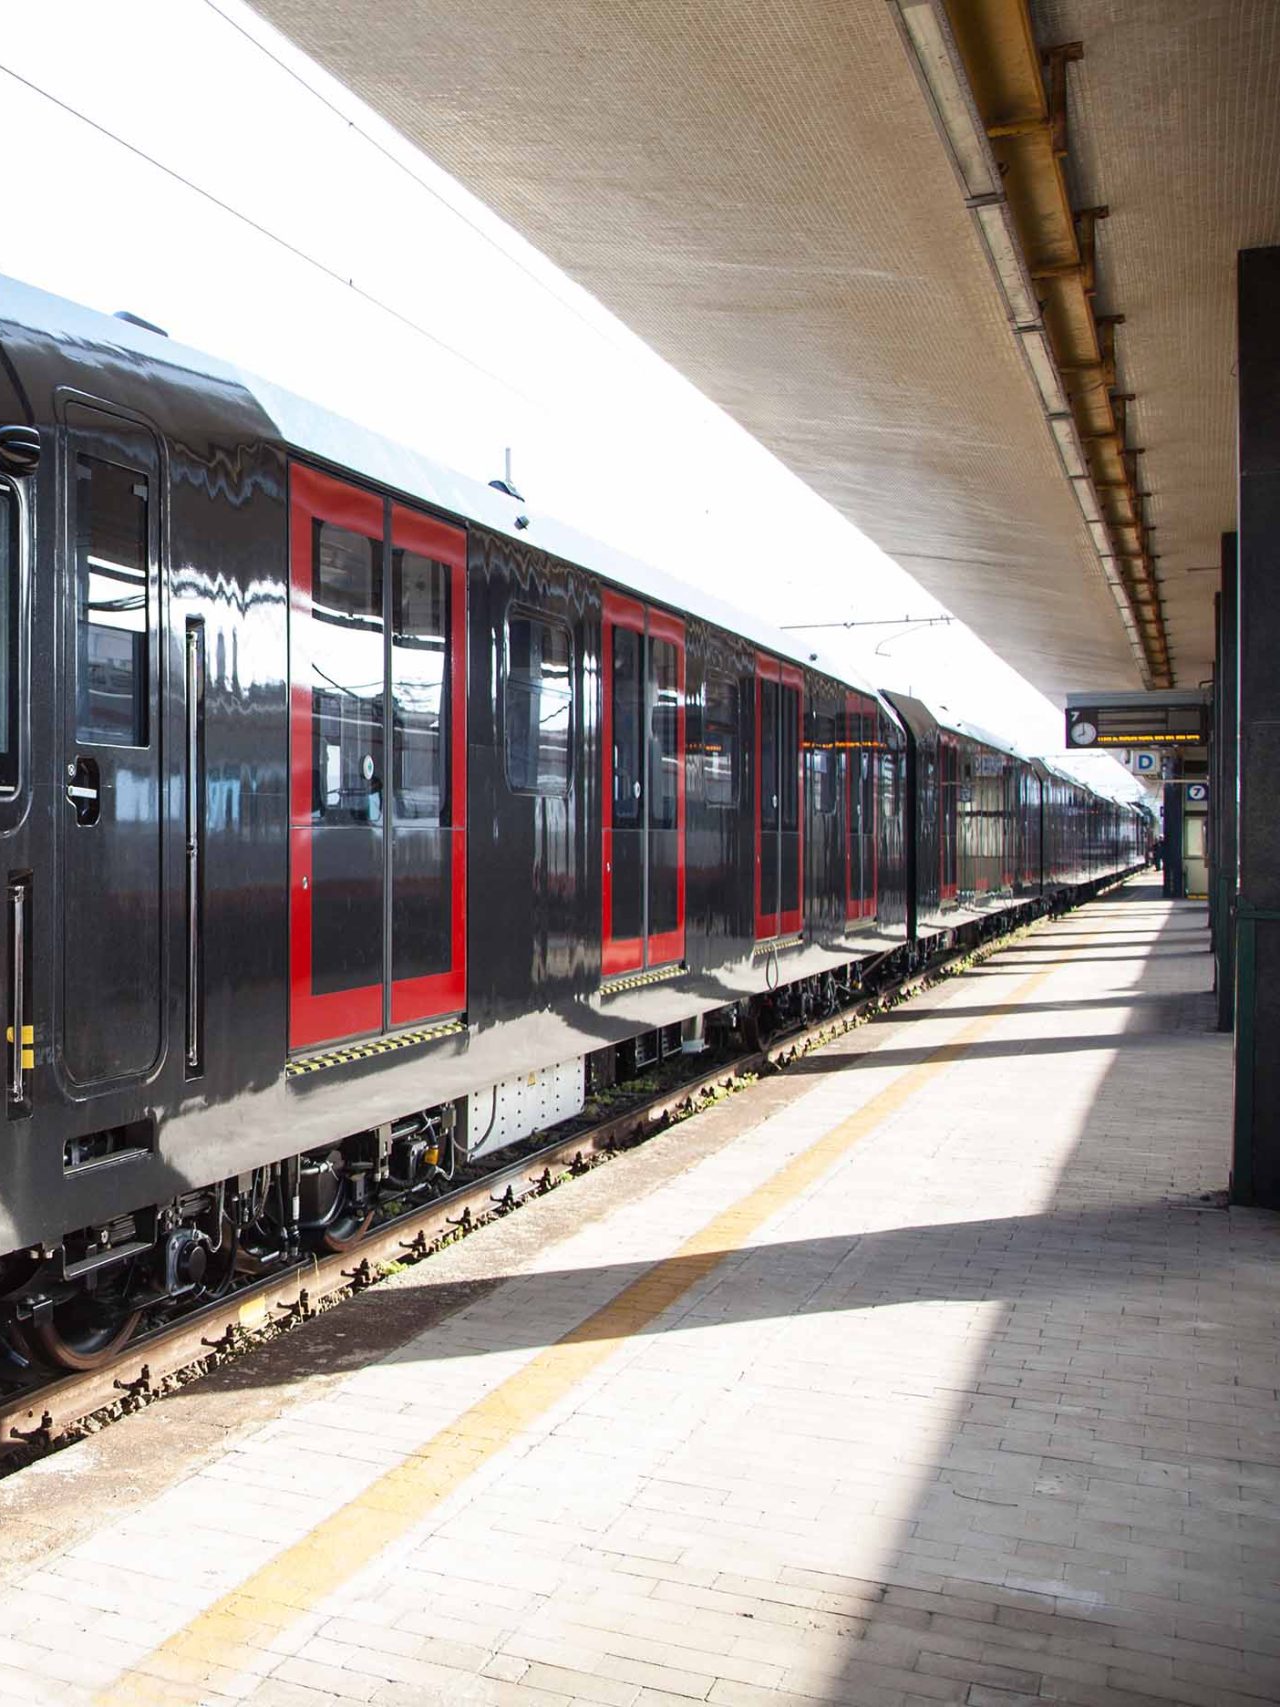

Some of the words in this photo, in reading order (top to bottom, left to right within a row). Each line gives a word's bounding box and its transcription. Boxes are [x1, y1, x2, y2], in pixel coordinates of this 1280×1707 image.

[1070, 711, 1080, 721] 7
[1138, 754, 1154, 769] D
[1193, 787, 1202, 797] 7
